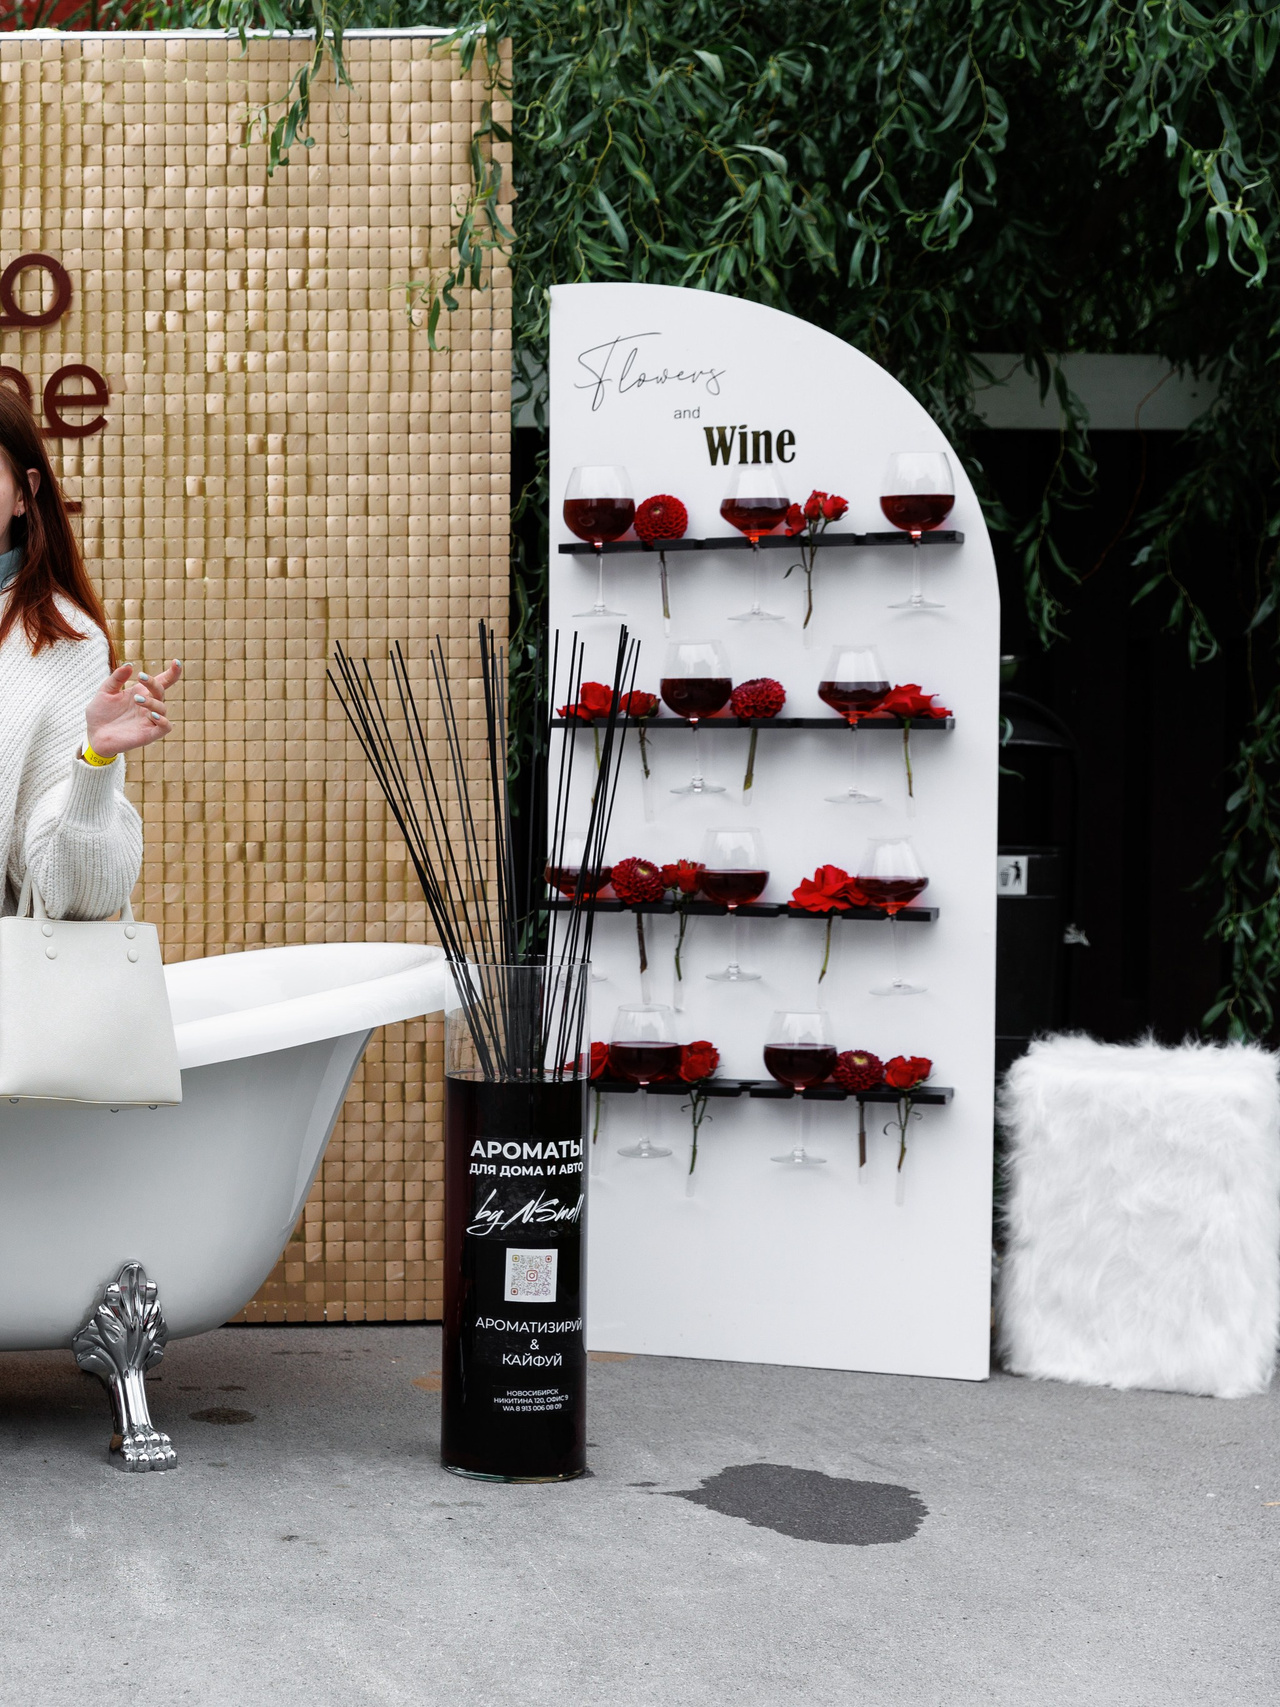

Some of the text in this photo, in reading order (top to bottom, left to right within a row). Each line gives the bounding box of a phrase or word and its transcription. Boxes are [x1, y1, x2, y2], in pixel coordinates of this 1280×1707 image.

[574, 332, 726, 411] Flowers
[673, 406, 700, 419] and
[703, 424, 796, 466] Wine
[470, 1138, 583, 1160] АРОМАТЫ
[469, 1162, 584, 1177] ДЛЯ ДОМА И АВТО
[466, 1189, 506, 1236] by
[475, 1317, 582, 1334] АРОМАТИЗИРУЙ
[530, 1339, 539, 1350] &
[502, 1353, 562, 1367] КАЙФУЙ
[506, 1388, 559, 1397] НОВОСИБИРСК
[546, 1395, 565, 1403] ОФИС
